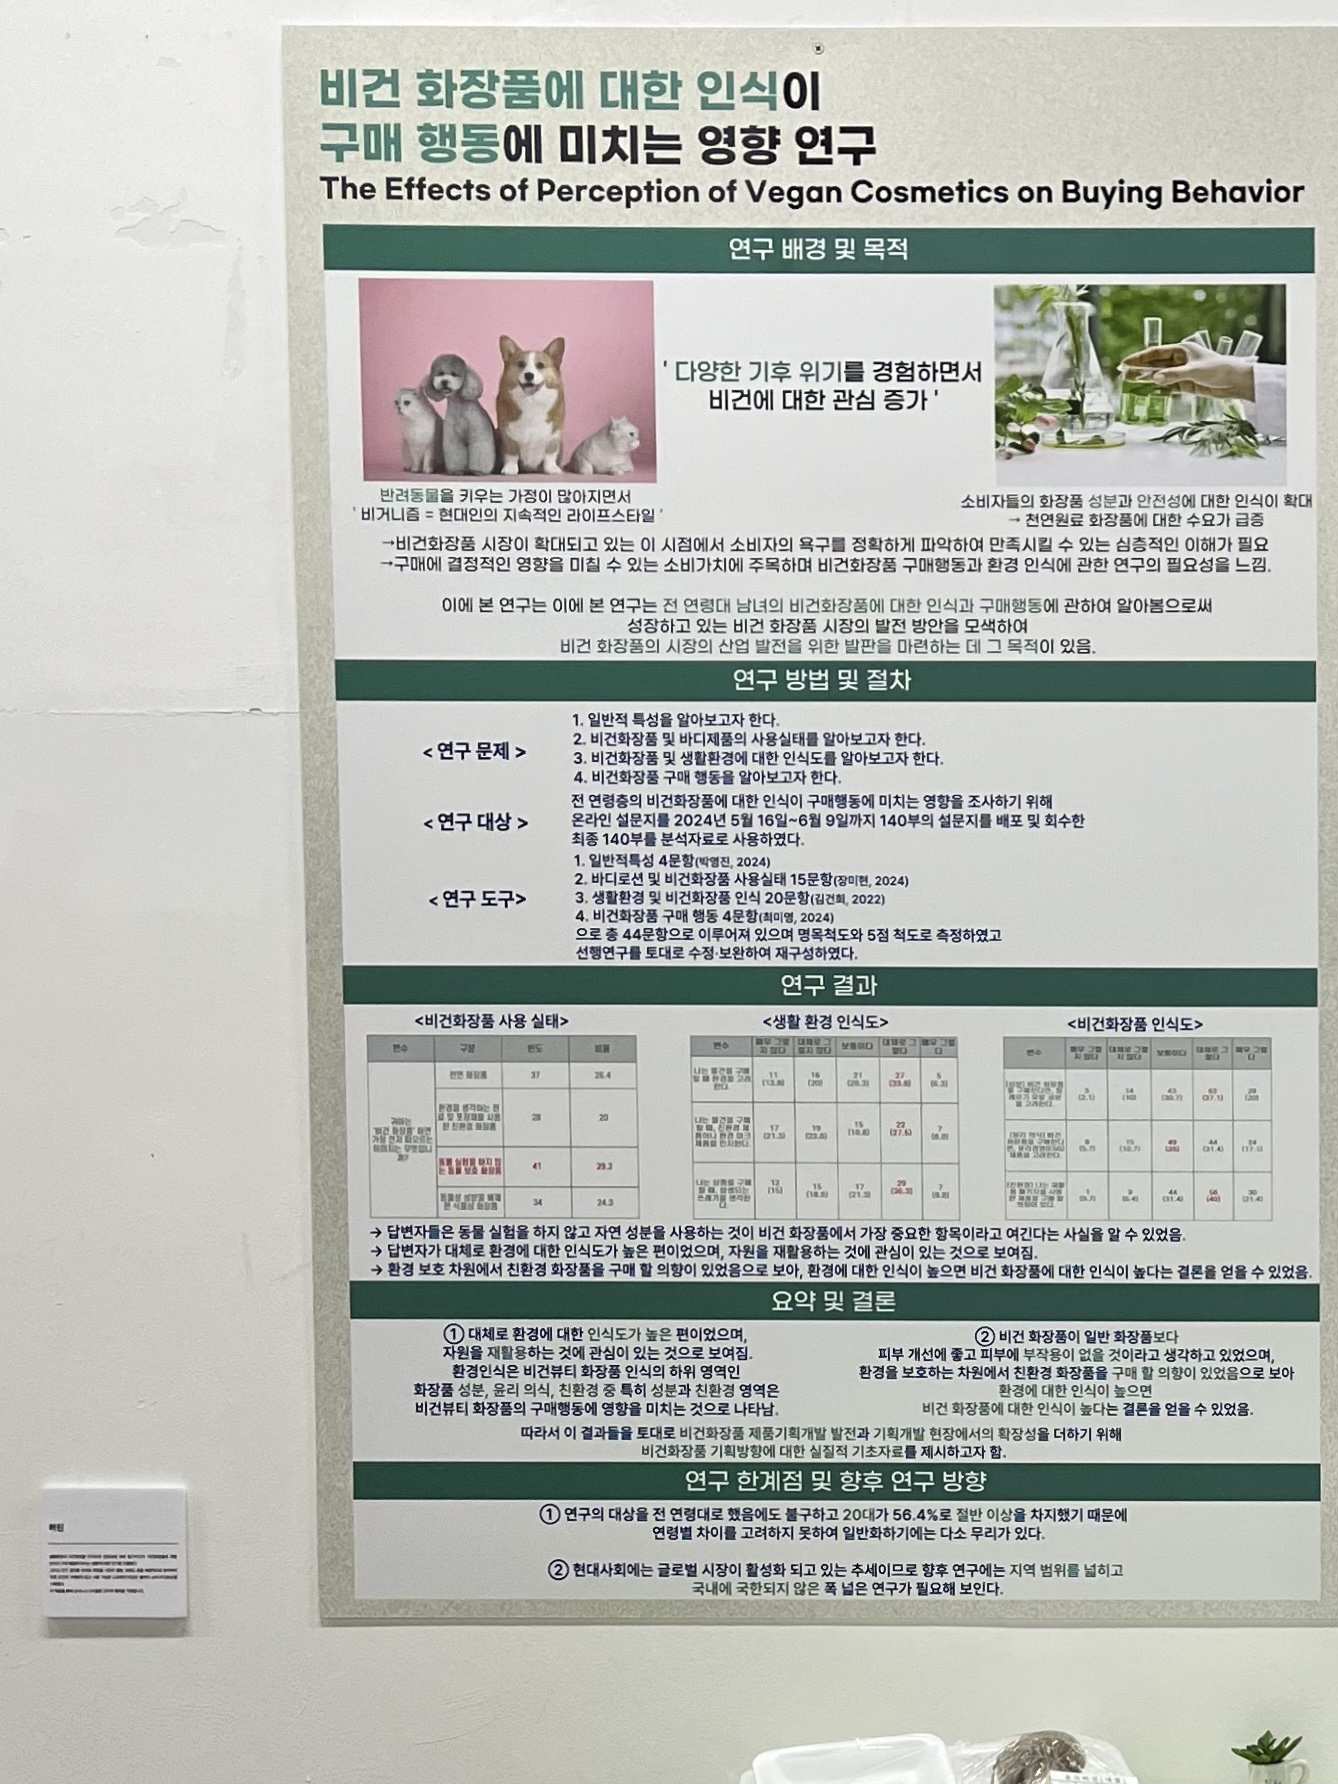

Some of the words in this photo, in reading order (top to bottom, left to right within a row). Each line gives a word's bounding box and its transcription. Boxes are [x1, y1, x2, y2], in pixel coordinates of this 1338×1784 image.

[320, 68, 401, 108] 비건
[416, 68, 584, 110] 화장품에
[600, 69, 683, 111] 대한
[697, 70, 820, 112] 인식이
[320, 122, 402, 163] 구매
[416, 122, 543, 164] 행동에
[559, 124, 683, 166] 미치는
[697, 124, 782, 166] 영향
[794, 125, 877, 167] 연구
[319, 175, 377, 200] The
[385, 176, 491, 202] Effects
[499, 177, 529, 202] of
[537, 177, 700, 209] Perception
[708, 178, 738, 203] of
[744, 179, 843, 210] Vegan
[850, 178, 1009, 204] Cosmetics
[1017, 185, 1053, 204] on
[1062, 178, 1163, 211] Buying
[1172, 177, 1306, 204] Behavior
[729, 237, 775, 261] 연구
[782, 237, 826, 261] 배경
[834, 237, 856, 261] 및
[863, 237, 908, 261] 목적
[675, 360, 742, 383] 다양한
[749, 360, 792, 383] 기후
[799, 360, 865, 383] 위기를
[872, 360, 982, 383] 경험하면서
[709, 388, 774, 411] 비건에
[782, 388, 827, 412] 대한
[832, 389, 875, 411] 관심
[883, 389, 929, 412] 증가
[380, 487, 454, 504] 반려동물을
[459, 488, 504, 504] 키우는
[508, 488, 552, 504] 가정이
[557, 489, 631, 505] 많아지면서
[361, 506, 420, 522] 비거니즘
[438, 507, 498, 523] 현대인의
[502, 507, 562, 523] 지속적인
[567, 508, 655, 523] 라이프스타일
[1025, 512, 1084, 528] 천연원료
[1088, 512, 1148, 528] 화장품에
[1152, 512, 1183, 528] 대한
[1186, 512, 1231, 528] 수요가
[1235, 512, 1264, 528] 급증
[733, 668, 778, 692] 연구
[785, 668, 829, 691] 방법
[837, 668, 859, 691] 및
[866, 668, 912, 692] 절차
[572, 713, 584, 727] 1.
[587, 711, 628, 728] 일반적
[631, 711, 674, 728] 특성을
[676, 712, 746, 728] 알아보고자
[748, 712, 780, 729] 한다.
[437, 740, 472, 761] 연구
[475, 741, 510, 761] 문제
[437, 811, 473, 832] 연구
[477, 811, 513, 832] 대상
[442, 889, 477, 909] 연구
[480, 890, 518, 909] 도구
[781, 974, 826, 997] 연구
[833, 974, 878, 997] 결과
[414, 1012, 495, 1029] <비건화장품
[498, 1013, 528, 1029] 사용
[530, 1013, 569, 1030] 실태>
[762, 1013, 801, 1030] <생활
[804, 1013, 833, 1030] 환경
[836, 1014, 889, 1031] 인식도>
[1067, 1016, 1148, 1033] <비건화장품
[1151, 1016, 1204, 1033] 인식도>
[771, 1290, 817, 1312] 요약
[823, 1290, 844, 1312] 및
[852, 1290, 896, 1313] 결론
[999, 1329, 1025, 1345] 비건
[1028, 1329, 1081, 1345] 화장품이
[1084, 1329, 1111, 1345] 일반
[1113, 1329, 1180, 1345] 화장품보다
[685, 1470, 730, 1493] 연구
[736, 1469, 803, 1492] 한계점
[811, 1470, 832, 1492] 및
[839, 1469, 884, 1493] 향후
[891, 1470, 935, 1493] 연구
[942, 1470, 988, 1493] 방향
[652, 1525, 693, 1541] 연령별
[696, 1525, 737, 1541] 차이를
[740, 1525, 794, 1541] 고려하지
[798, 1525, 838, 1541] 못하여
[842, 1525, 937, 1541] 일반화하기에는
[940, 1525, 968, 1542] 다소
[970, 1526, 1012, 1542] 무리가
[1014, 1526, 1045, 1541] 있다.
